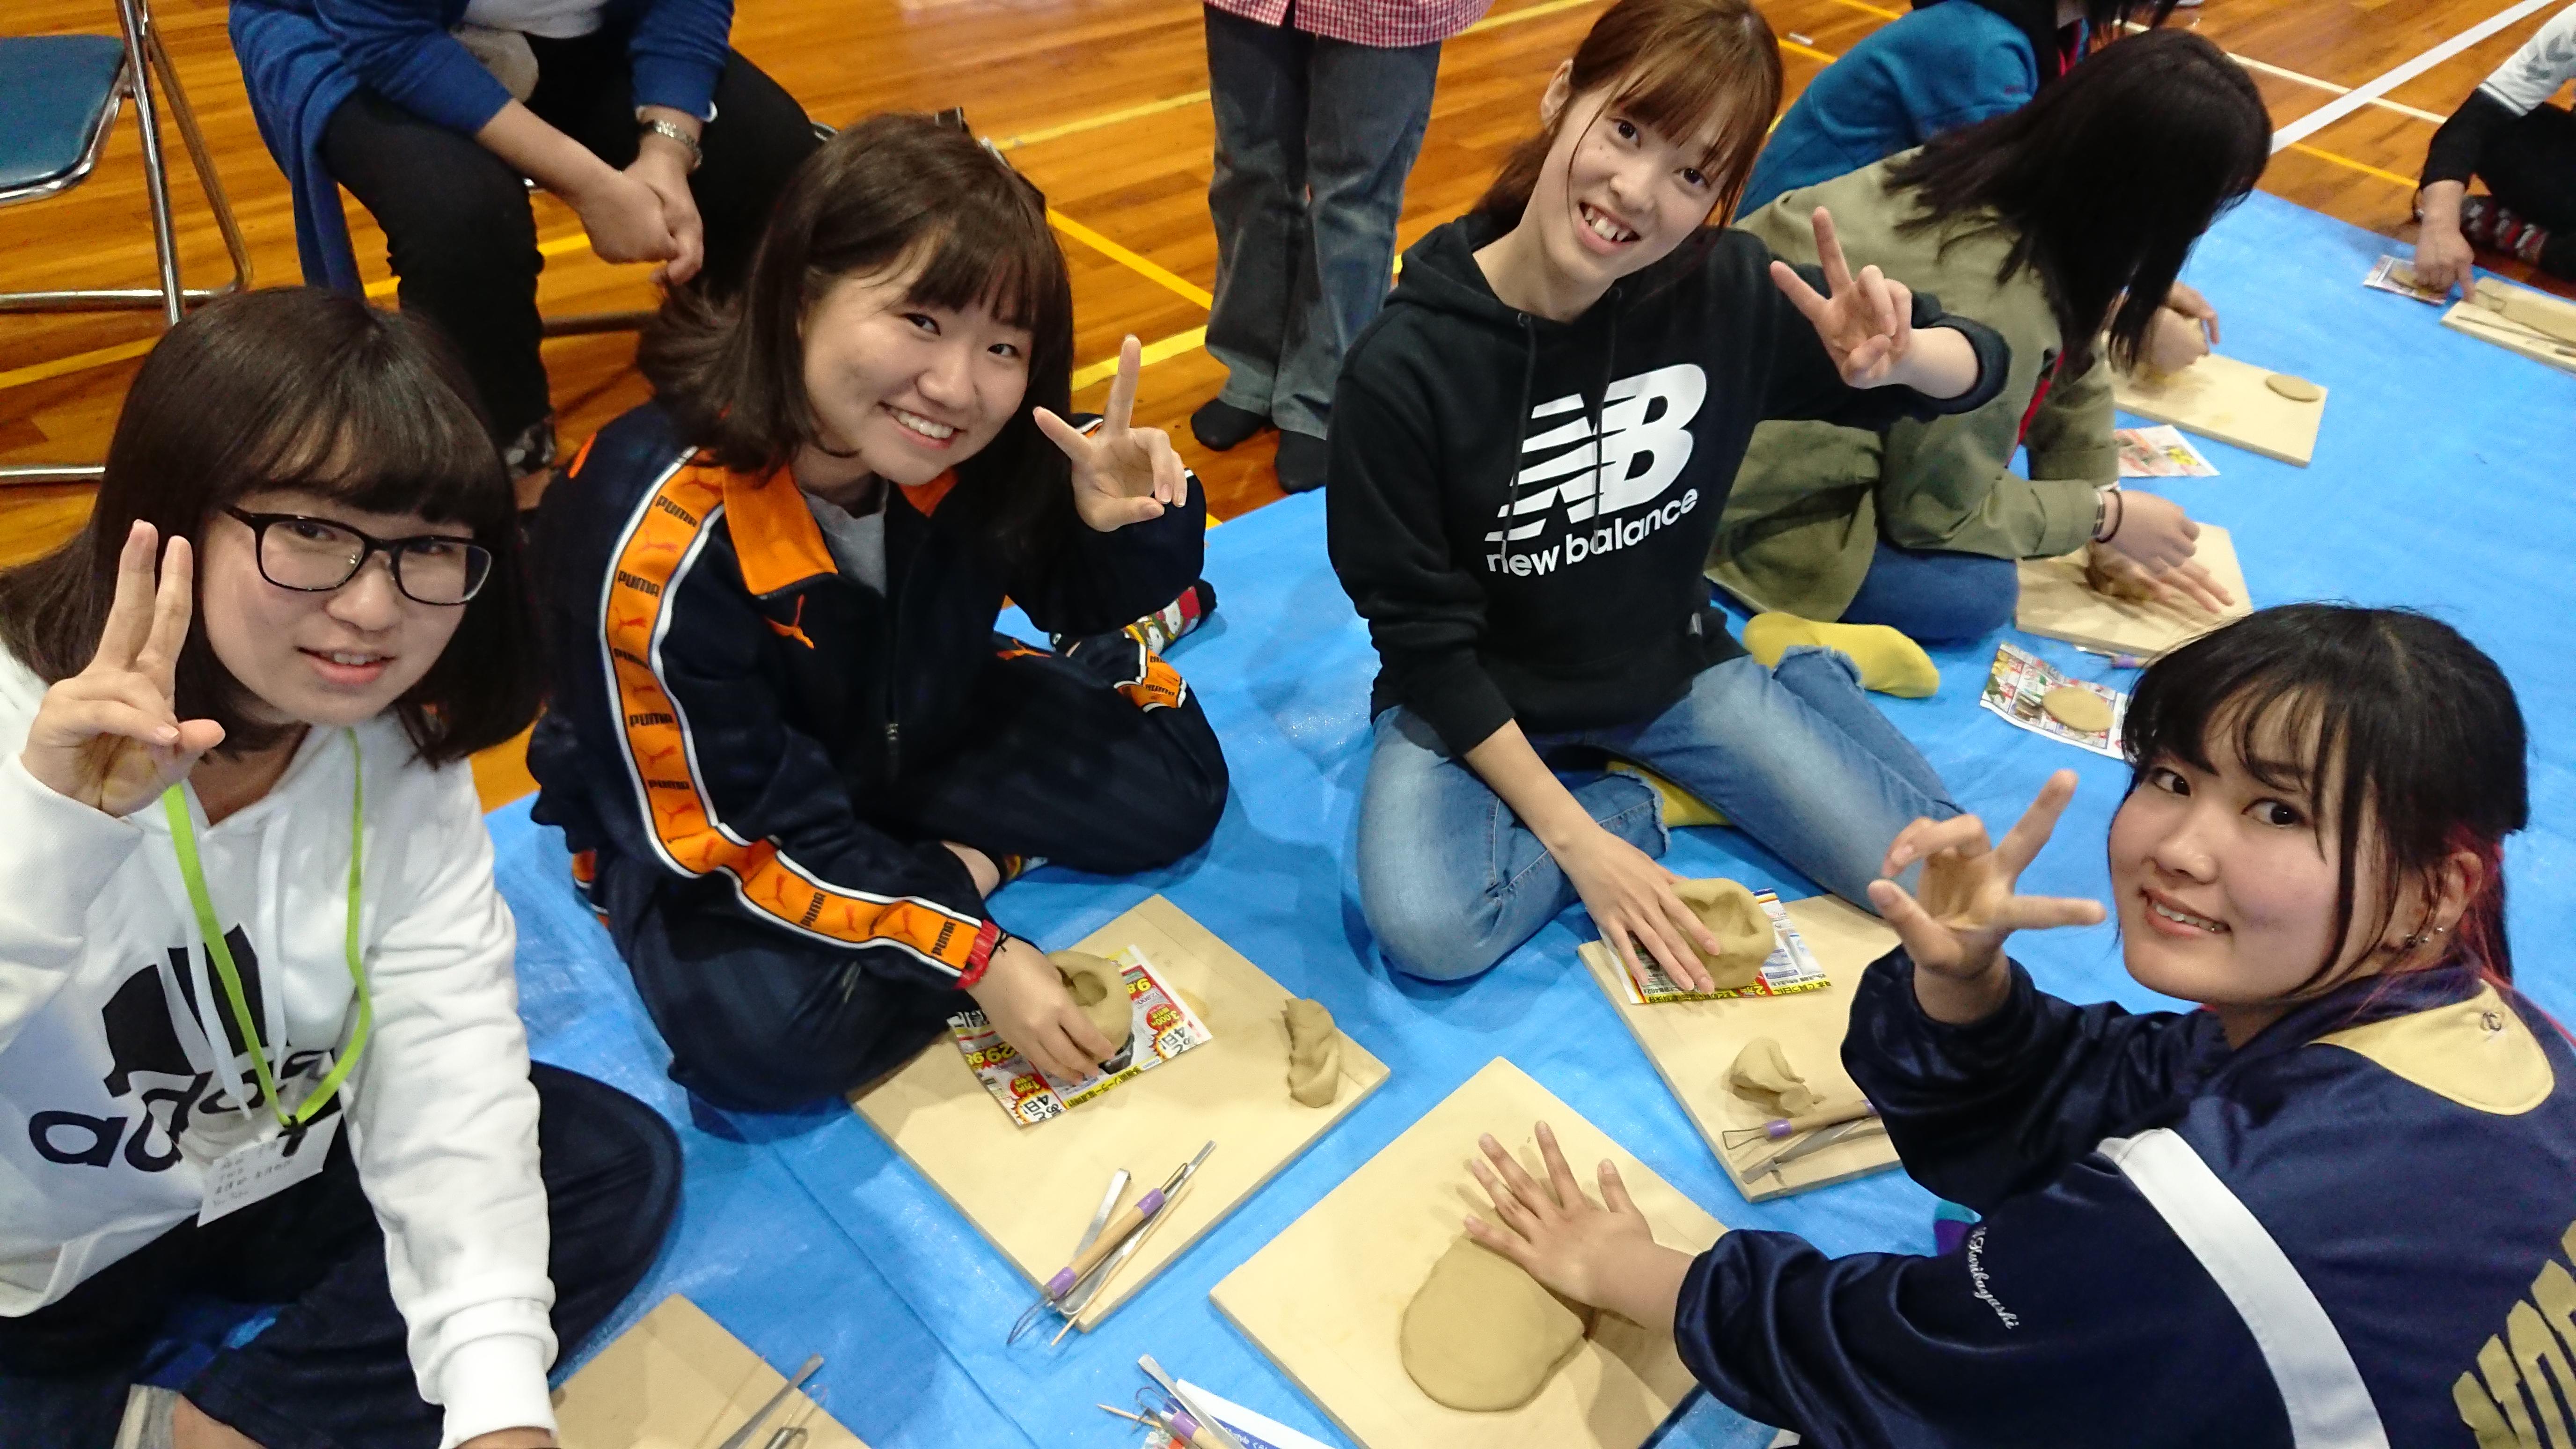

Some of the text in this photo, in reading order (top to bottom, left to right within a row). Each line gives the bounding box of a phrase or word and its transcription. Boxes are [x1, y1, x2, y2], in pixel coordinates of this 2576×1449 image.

[1485, 363, 1707, 542] NB
[656, 495, 698, 527] PUMA
[1486, 488, 1698, 577] new balance
[617, 570, 660, 598] PUMA
[629, 712, 673, 727] PUMA
[648, 780, 689, 790] PUMA
[800, 892, 826, 928] PUMA
[931, 921, 956, 957] PUMA
